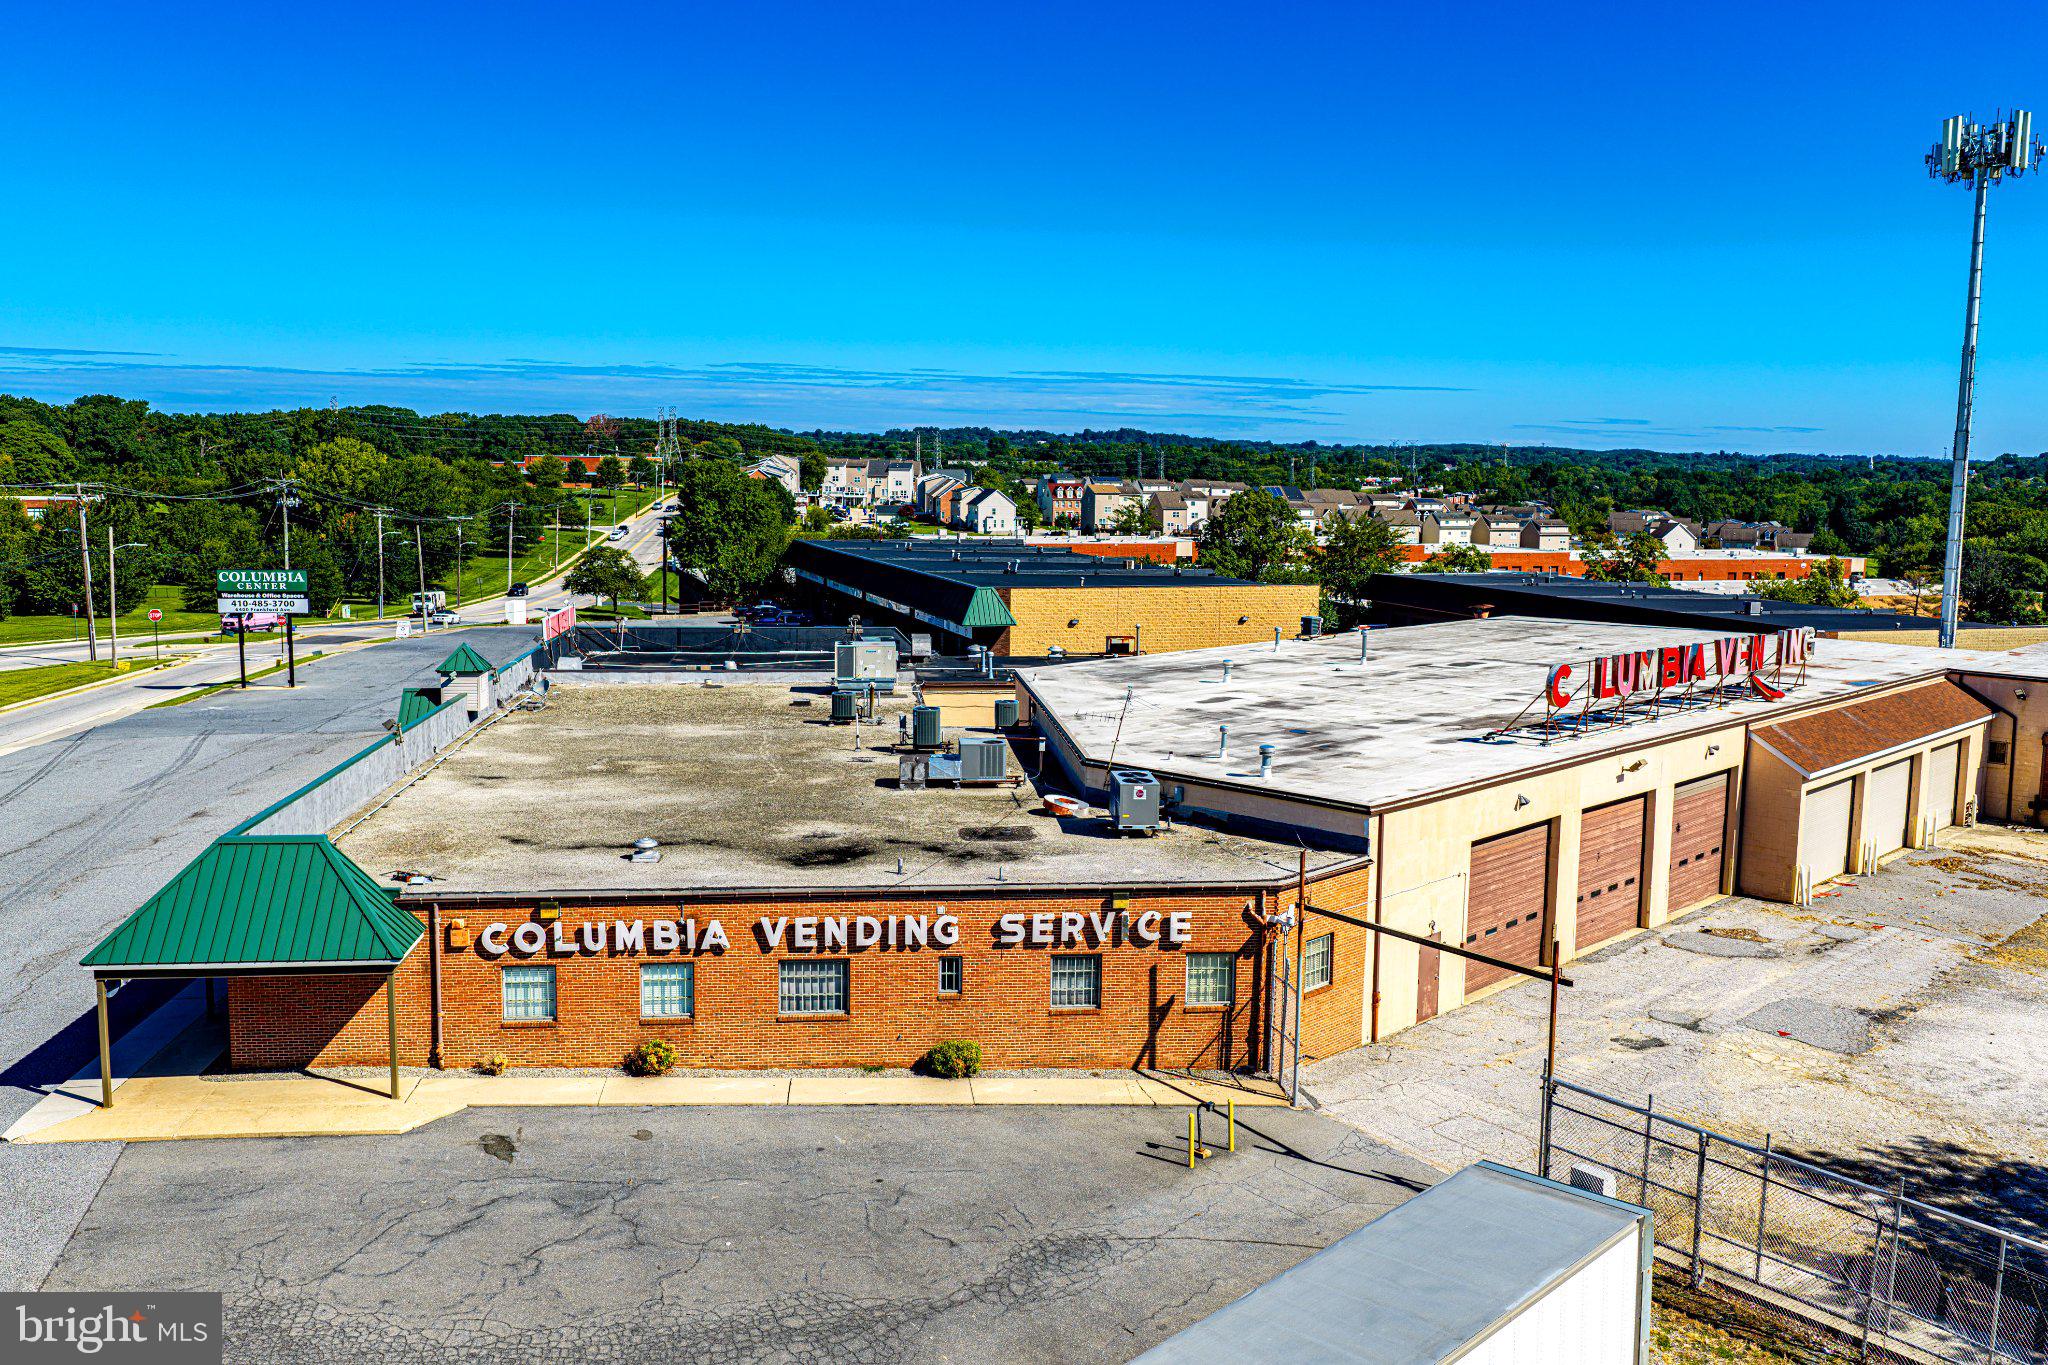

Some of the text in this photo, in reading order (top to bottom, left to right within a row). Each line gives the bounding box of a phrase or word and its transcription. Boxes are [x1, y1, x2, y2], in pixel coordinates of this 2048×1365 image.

[218, 571, 305, 583] COLUMBIA
[237, 582, 287, 590] CENTER
[282, 592, 305, 600] Spaces
[481, 910, 1192, 954] COLUMBIA VENDING SERVICE
